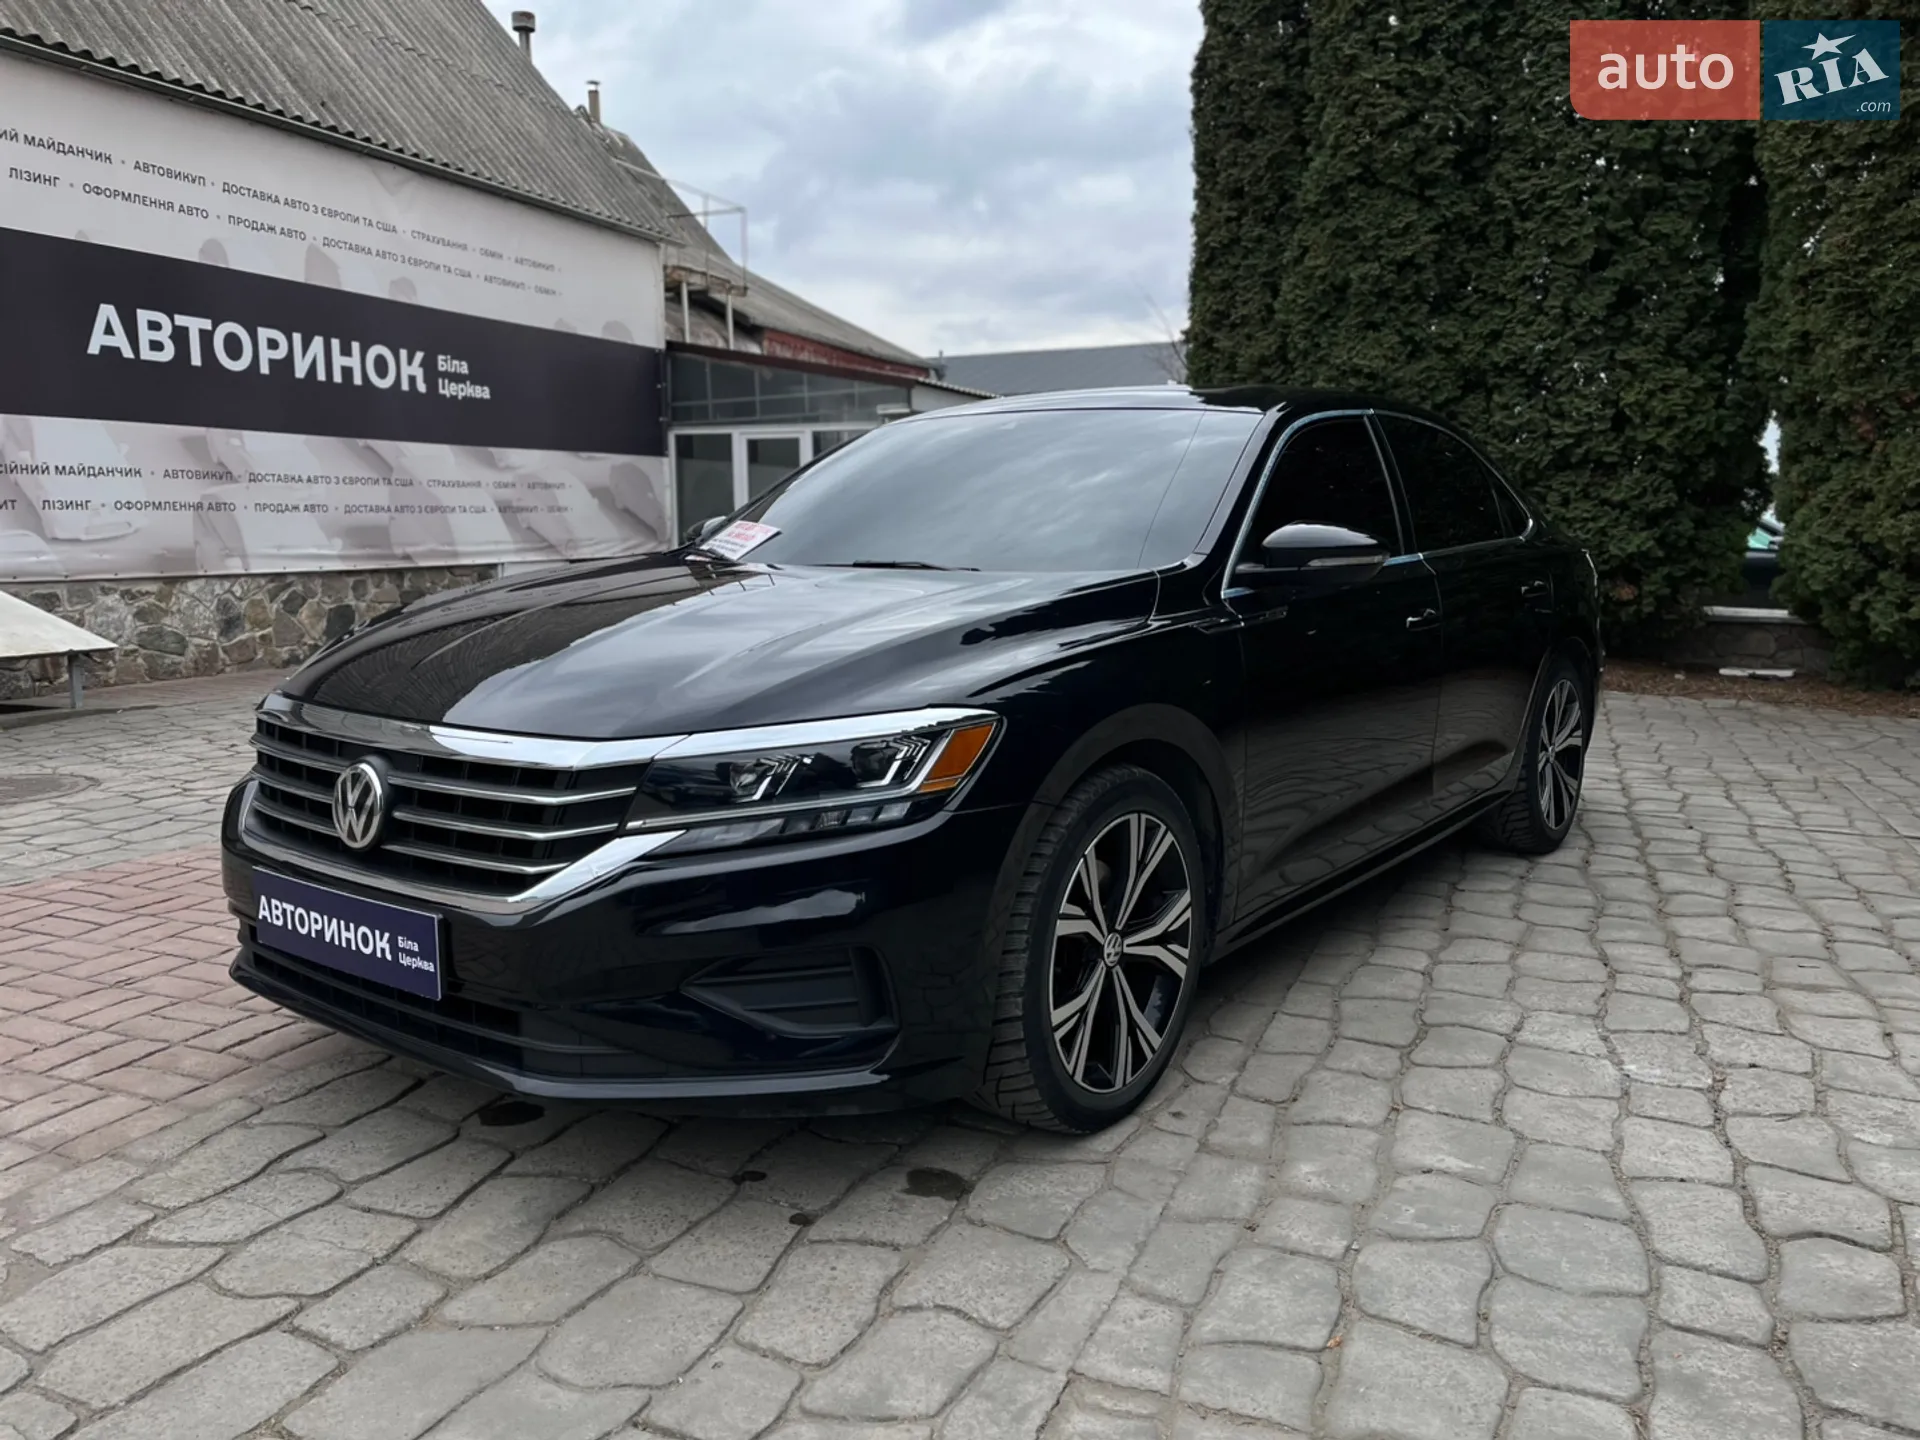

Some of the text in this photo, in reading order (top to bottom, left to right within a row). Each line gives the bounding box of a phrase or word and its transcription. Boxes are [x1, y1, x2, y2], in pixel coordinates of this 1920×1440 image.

[23, 133, 113, 165] МАЙДАНЧИК
[9, 166, 61, 188] ЛІЗИНГ
[133, 160, 207, 187] АВТОВИКУП
[83, 182, 209, 220] ОФОРМЛЕННЯ АВТО
[222, 181, 398, 235] ДОСТАВКА АВТО З ЄВРОПИ ТА США
[227, 214, 307, 241] ПРОДАЖ АВТО
[411, 229, 468, 251] СТРАХУВАННЯ
[322, 236, 373, 257] ДОСТАВКА
[375, 249, 399, 263] АВТО
[407, 256, 441, 273] ЄВРОПИ
[442, 263, 453, 275] ТА
[453, 267, 472, 279] США
[86, 302, 428, 394] АВТОРИНОК
[436, 354, 469, 376] Біла
[437, 378, 491, 401] Церква
[54, 462, 143, 479] МАЙДАНЧИК
[163, 468, 233, 481] АВТОВИКУП
[248, 472, 304, 484] ДОСТАВКА
[306, 474, 332, 485] АВТО
[341, 476, 380, 487] ЄВРОПИ
[381, 477, 393, 487] ТА
[394, 478, 414, 488] США
[426, 479, 482, 489] СТРАХУВАННЯ
[41, 499, 91, 511] ЛІЗИНГ
[113, 499, 236, 512] ОФОРМЛЕННЯ АВТО
[254, 502, 329, 514] ПРОДАЖ АВТО
[344, 503, 392, 515] ДОСТАВКА
[394, 504, 416, 514] АВТО
[424, 504, 456, 514] ЄВРОПИ
[458, 504, 468, 514] ТА
[469, 505, 487, 514] США
[258, 894, 392, 962] АВТОРИНОК
[397, 935, 419, 952] Біла
[398, 952, 435, 973] Церква
